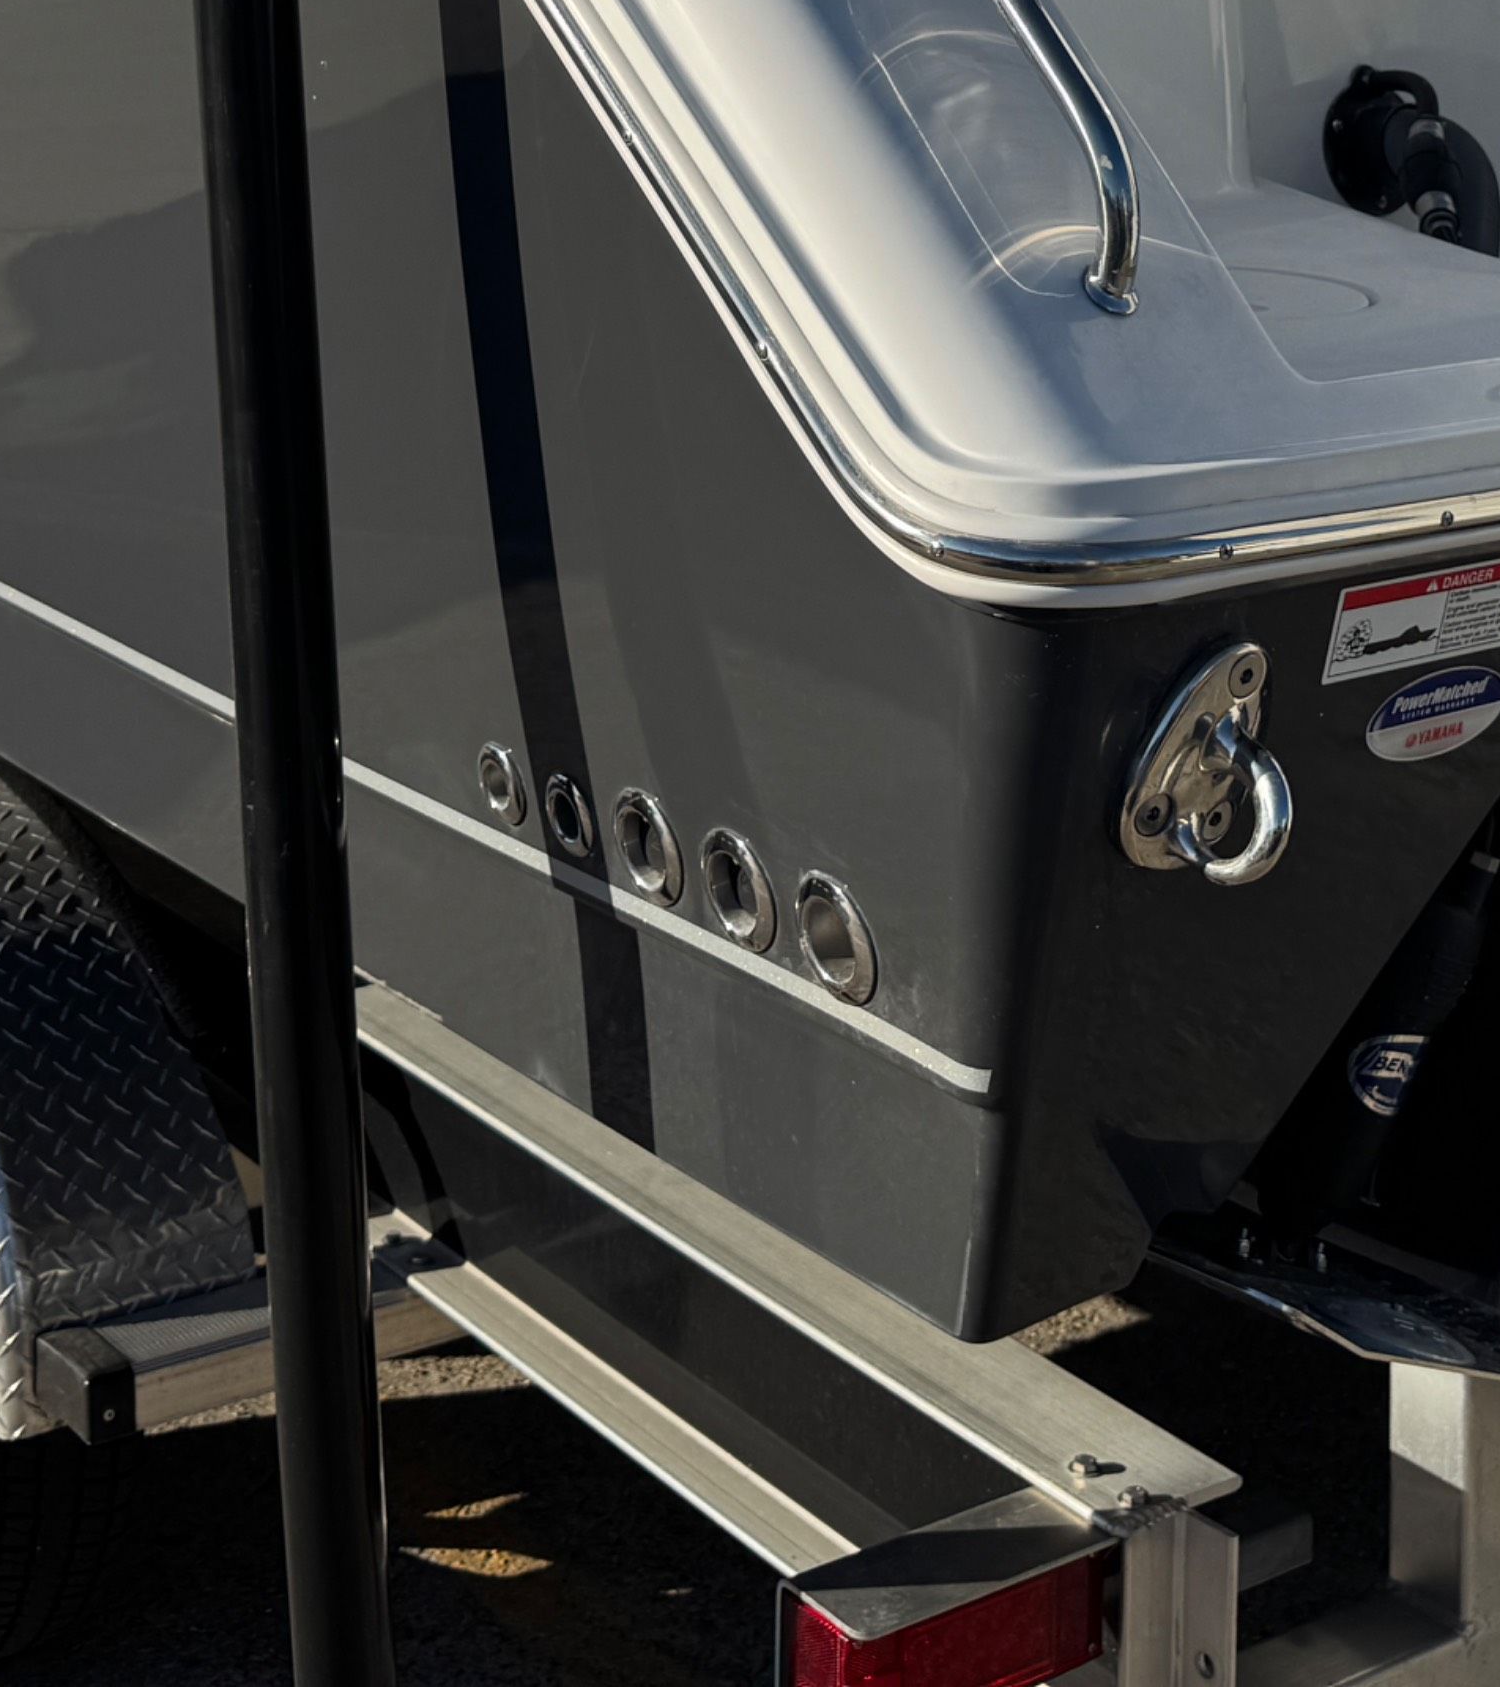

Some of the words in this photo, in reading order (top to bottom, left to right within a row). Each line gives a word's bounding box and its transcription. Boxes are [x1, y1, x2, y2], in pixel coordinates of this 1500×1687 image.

[1442, 568, 1494, 589] DANGER
[1391, 675, 1490, 715] PowerMatched
[1419, 721, 1464, 745] YAMAHA
